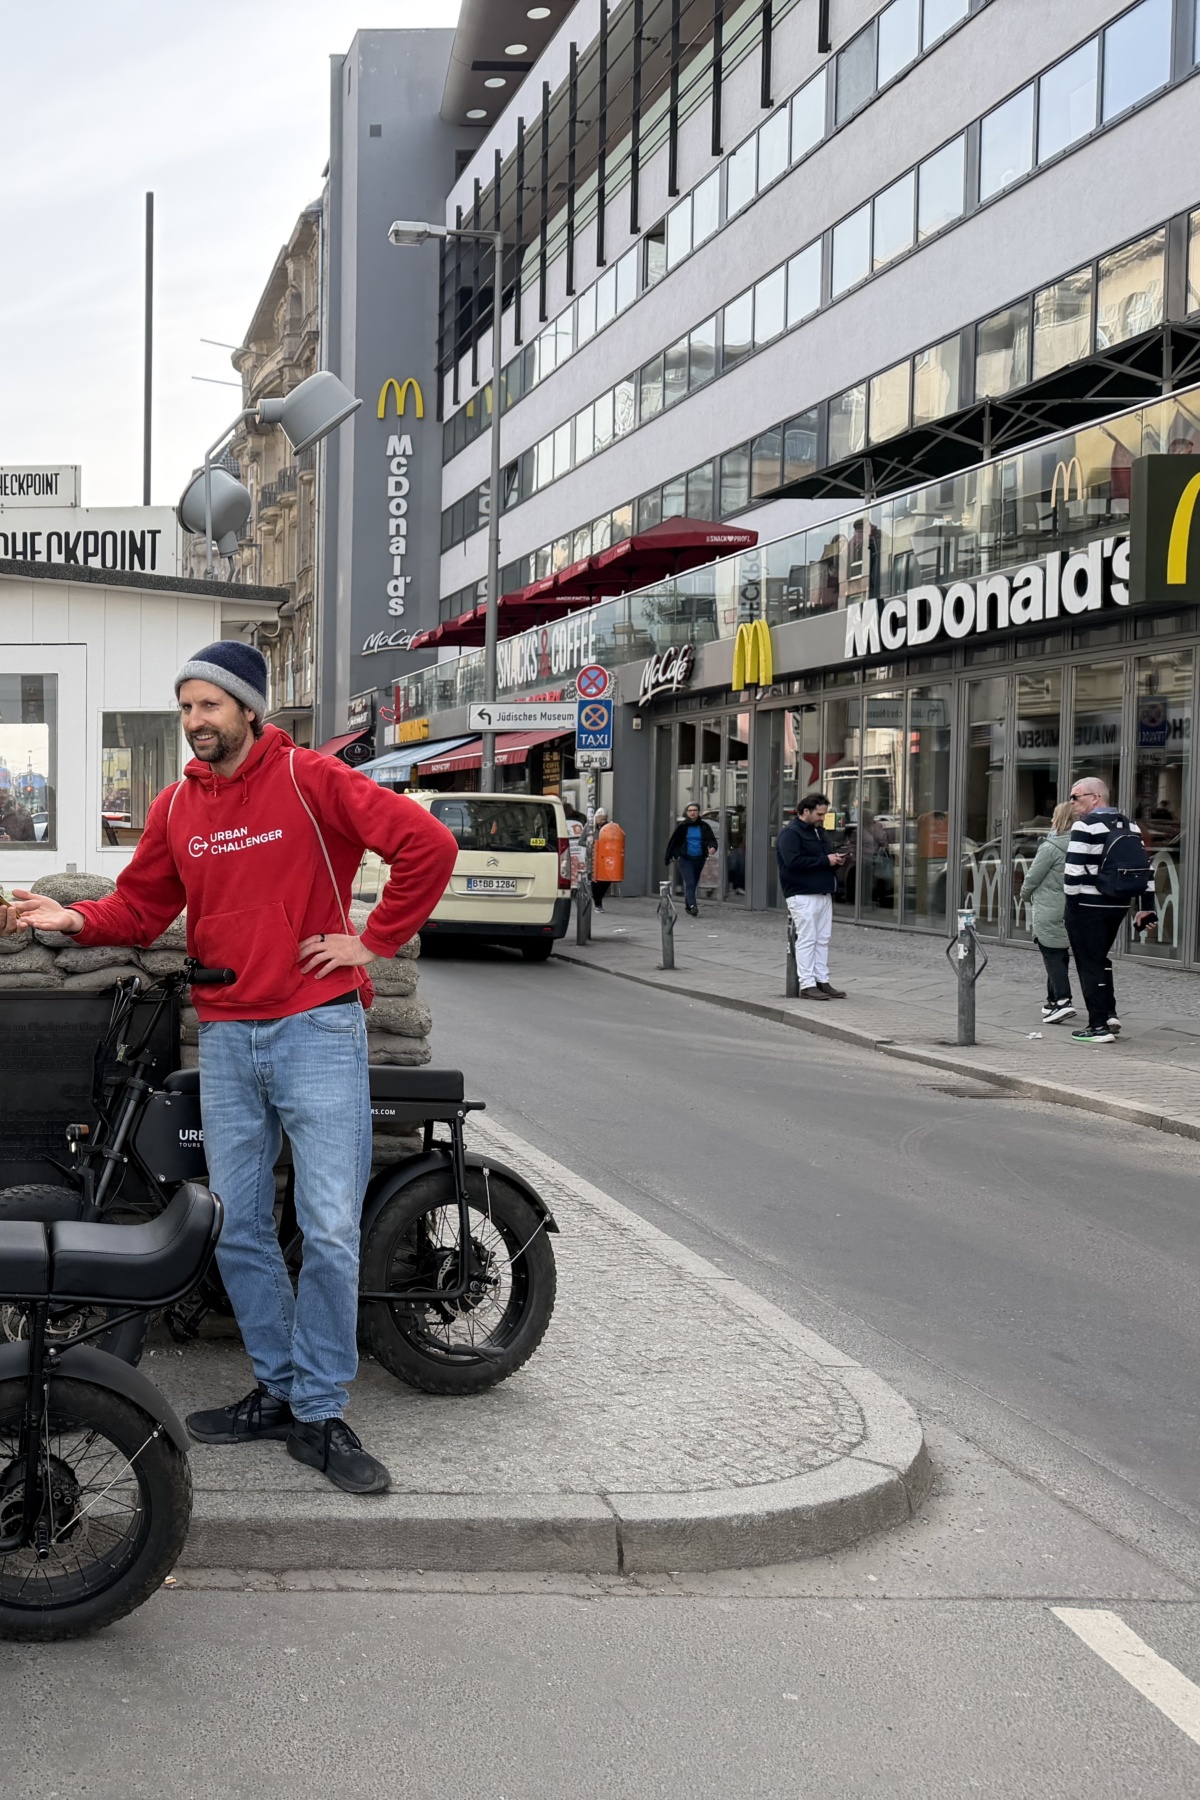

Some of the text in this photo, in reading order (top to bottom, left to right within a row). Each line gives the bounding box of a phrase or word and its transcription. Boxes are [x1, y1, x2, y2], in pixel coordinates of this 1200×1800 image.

[386, 434, 413, 616] McDonald's
[844, 536, 1130, 659] McDonald's
[364, 628, 423, 653] McCaf
[497, 633, 538, 689] SNACKS
[551, 613, 597, 676] COFFEE
[639, 644, 689, 700] McCafé
[496, 711, 574, 722] Jüdisches Museum
[580, 734, 608, 745] TAXI
[210, 826, 248, 842] URBAN
[211, 829, 283, 855] CHALLENGER
[496, 880, 515, 889] 1284
[370, 1108, 396, 1116] RS.COM
